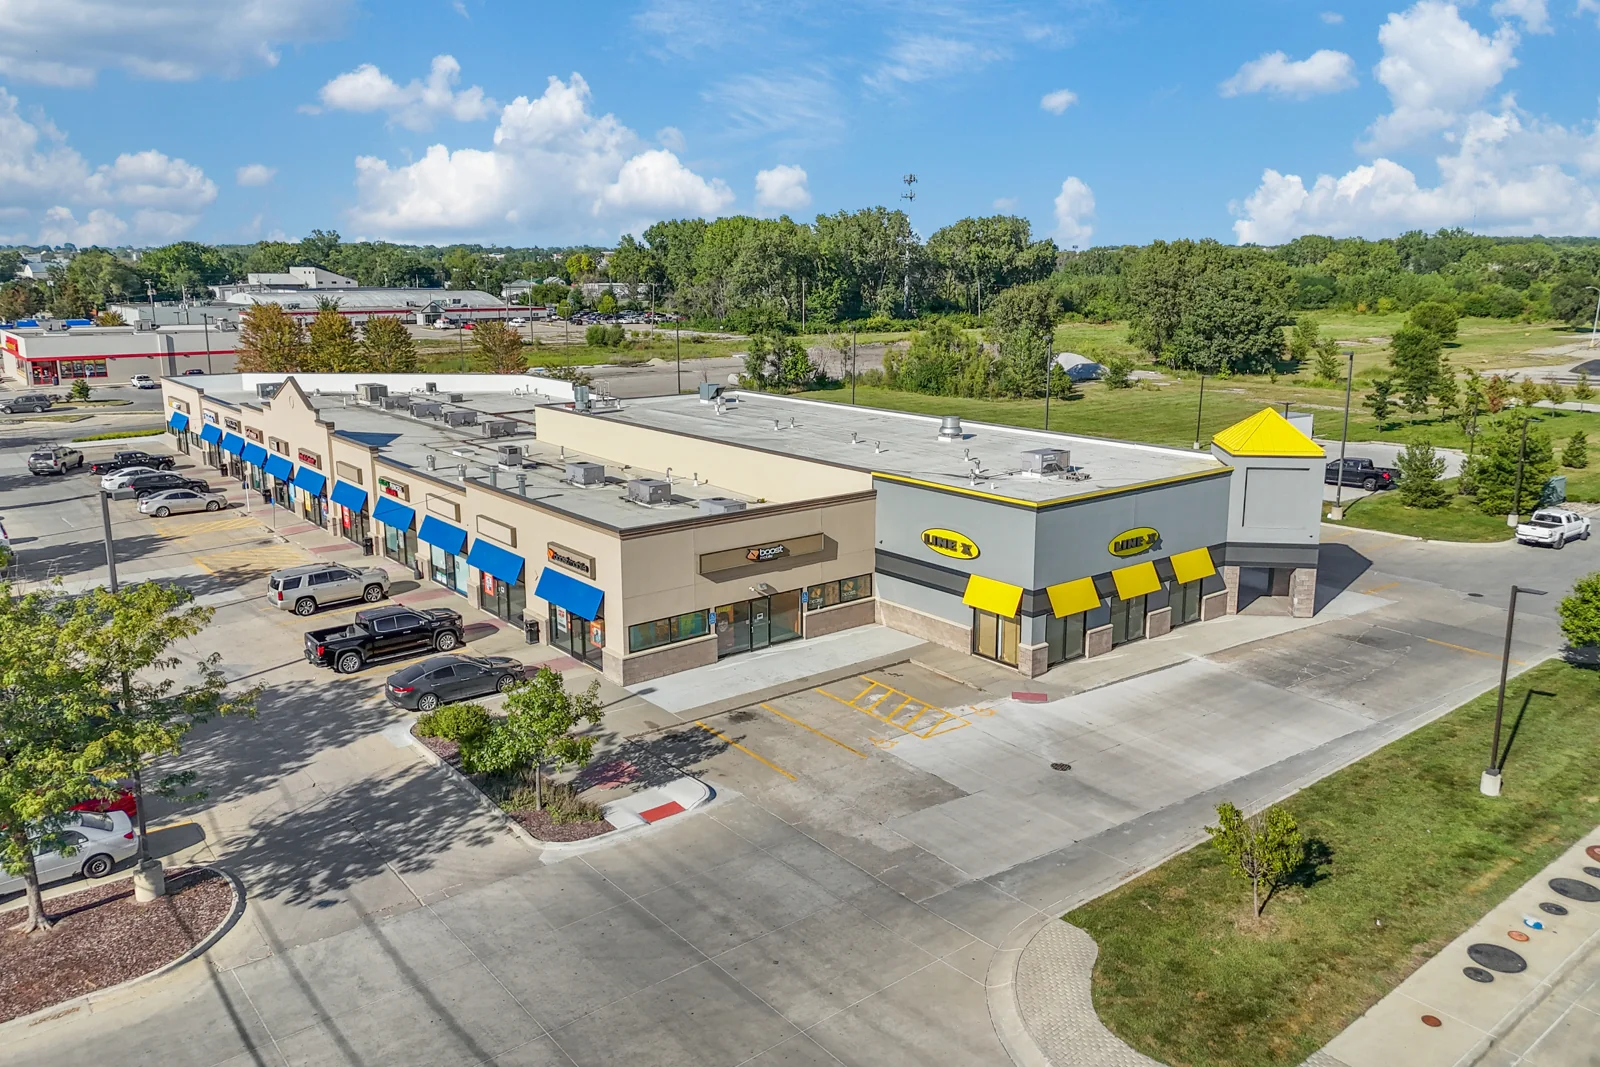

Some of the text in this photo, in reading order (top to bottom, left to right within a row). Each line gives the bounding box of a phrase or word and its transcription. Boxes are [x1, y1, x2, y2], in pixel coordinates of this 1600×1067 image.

[760, 545, 783, 556] boost
[924, 533, 973, 557] LINE X
[1114, 533, 1157, 552] LINE X
